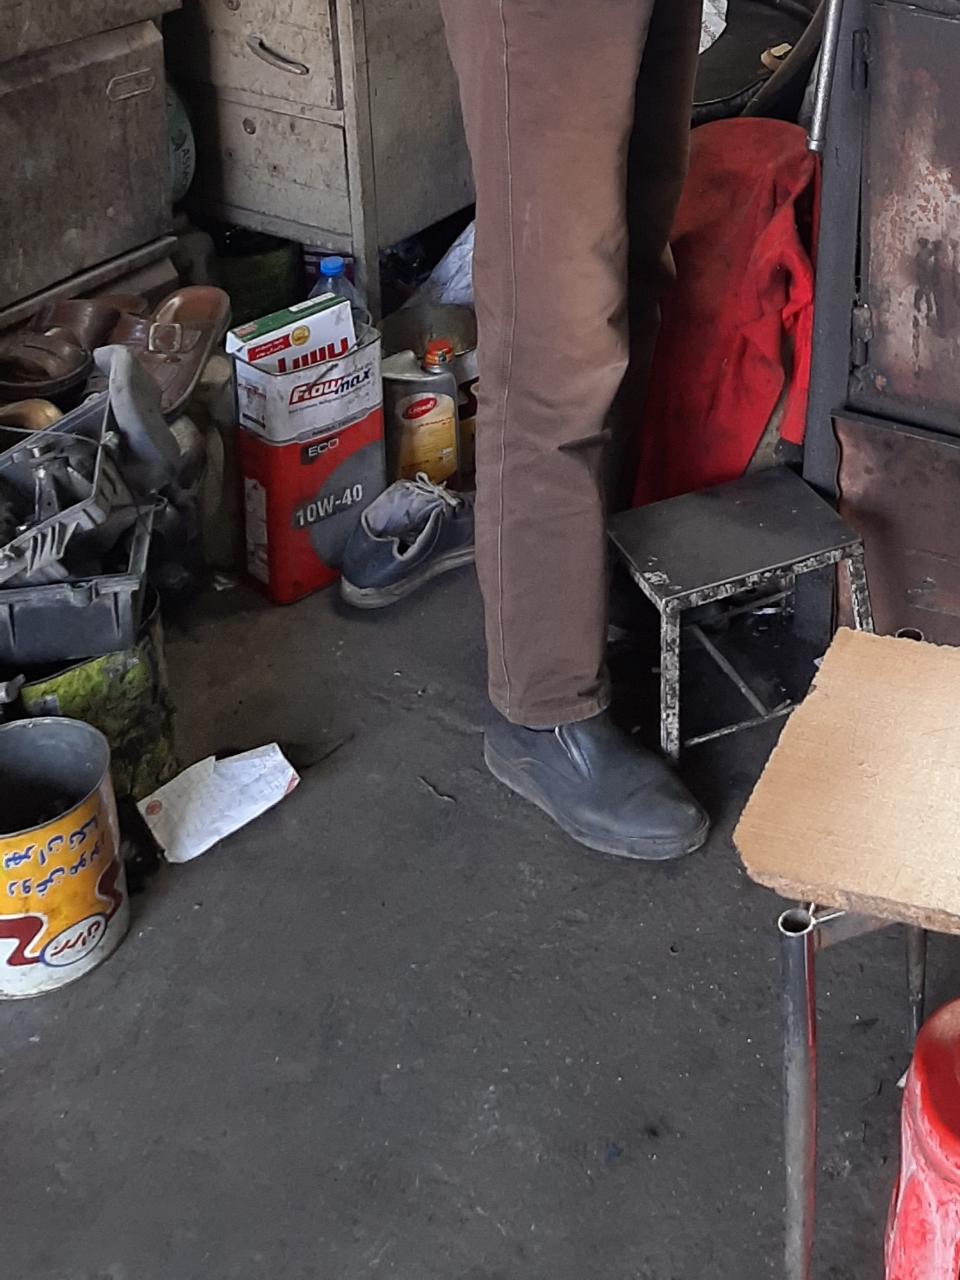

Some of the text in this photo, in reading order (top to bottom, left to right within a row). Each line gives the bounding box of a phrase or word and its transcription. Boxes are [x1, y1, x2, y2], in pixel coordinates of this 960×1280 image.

[308, 438, 339, 457] ECO
[296, 483, 364, 527] 10W-40
[50, 920, 101, 957] بهران
